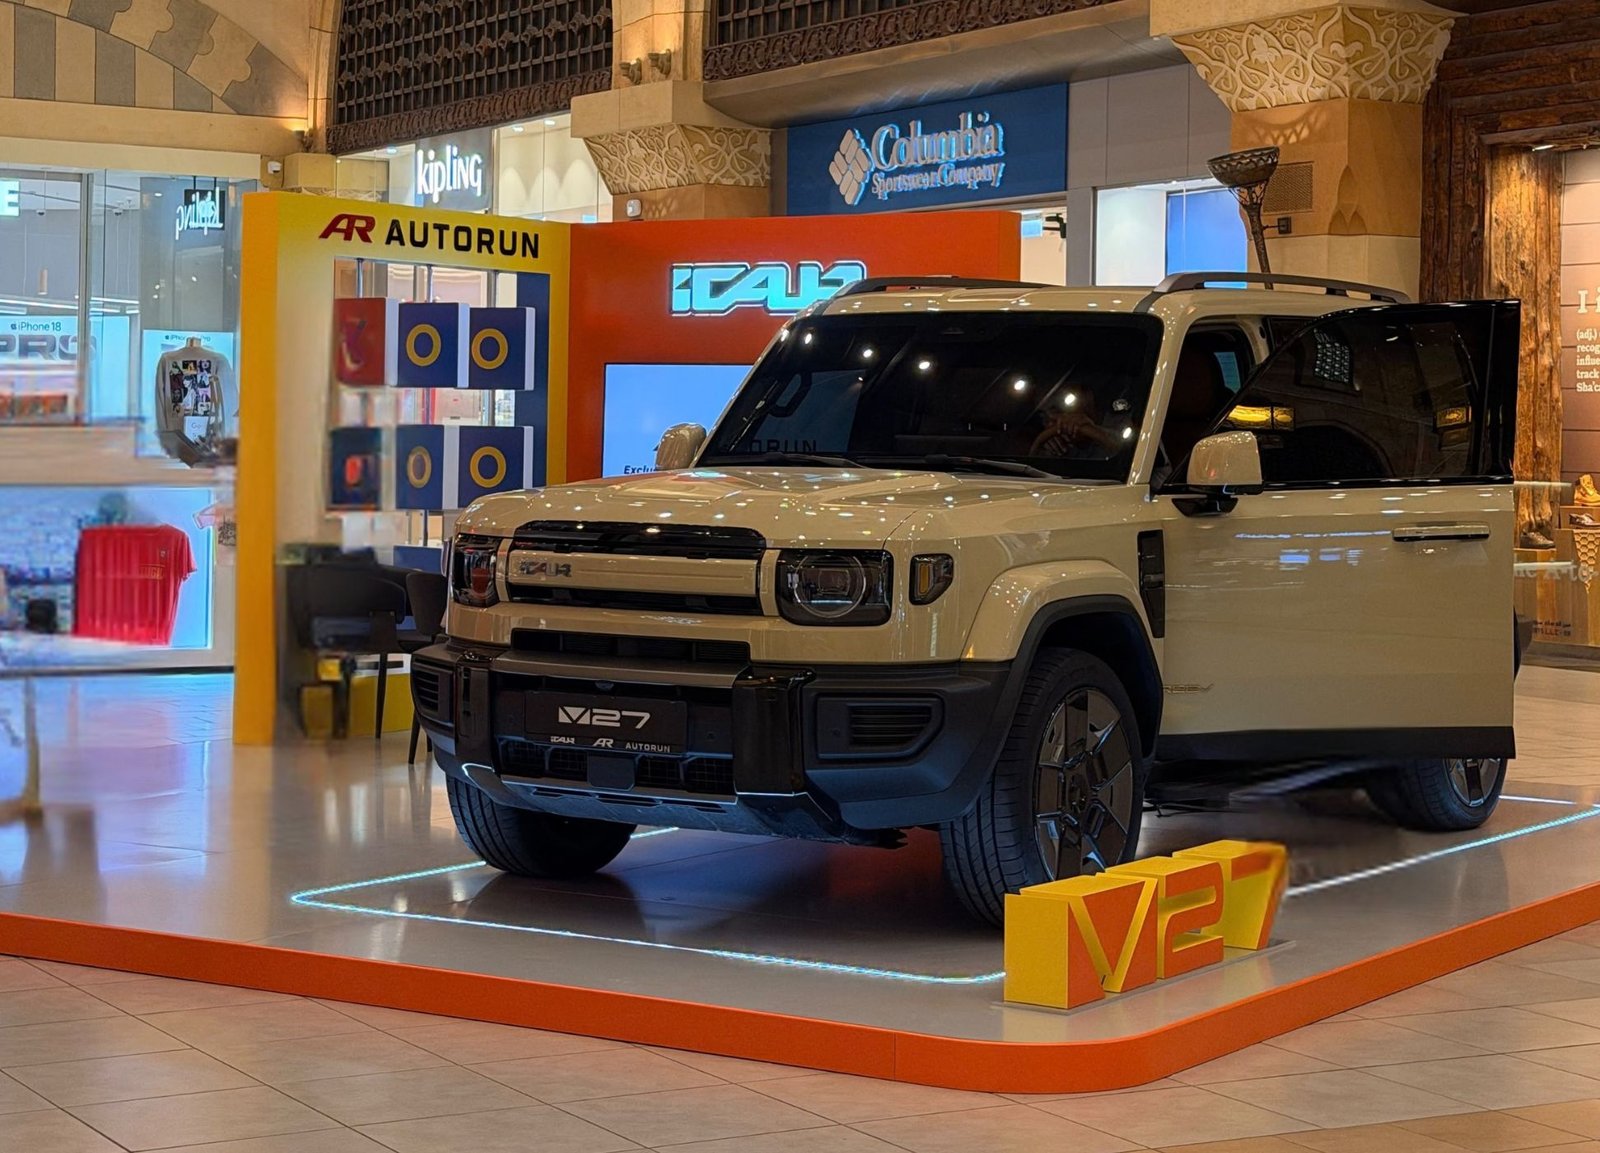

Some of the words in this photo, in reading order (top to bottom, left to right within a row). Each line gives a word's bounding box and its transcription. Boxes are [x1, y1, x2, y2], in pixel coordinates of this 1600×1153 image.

[870, 111, 1005, 172] Columbia
[871, 172, 941, 200] Sportswear
[937, 163, 1006, 189] Company
[318, 213, 376, 244] AR
[385, 219, 539, 259] AUTORUN
[18, 321, 50, 332] iPhone
[1576, 368, 1599, 379] track
[592, 737, 614, 749] AR
[625, 741, 671, 754] AUTORUN
